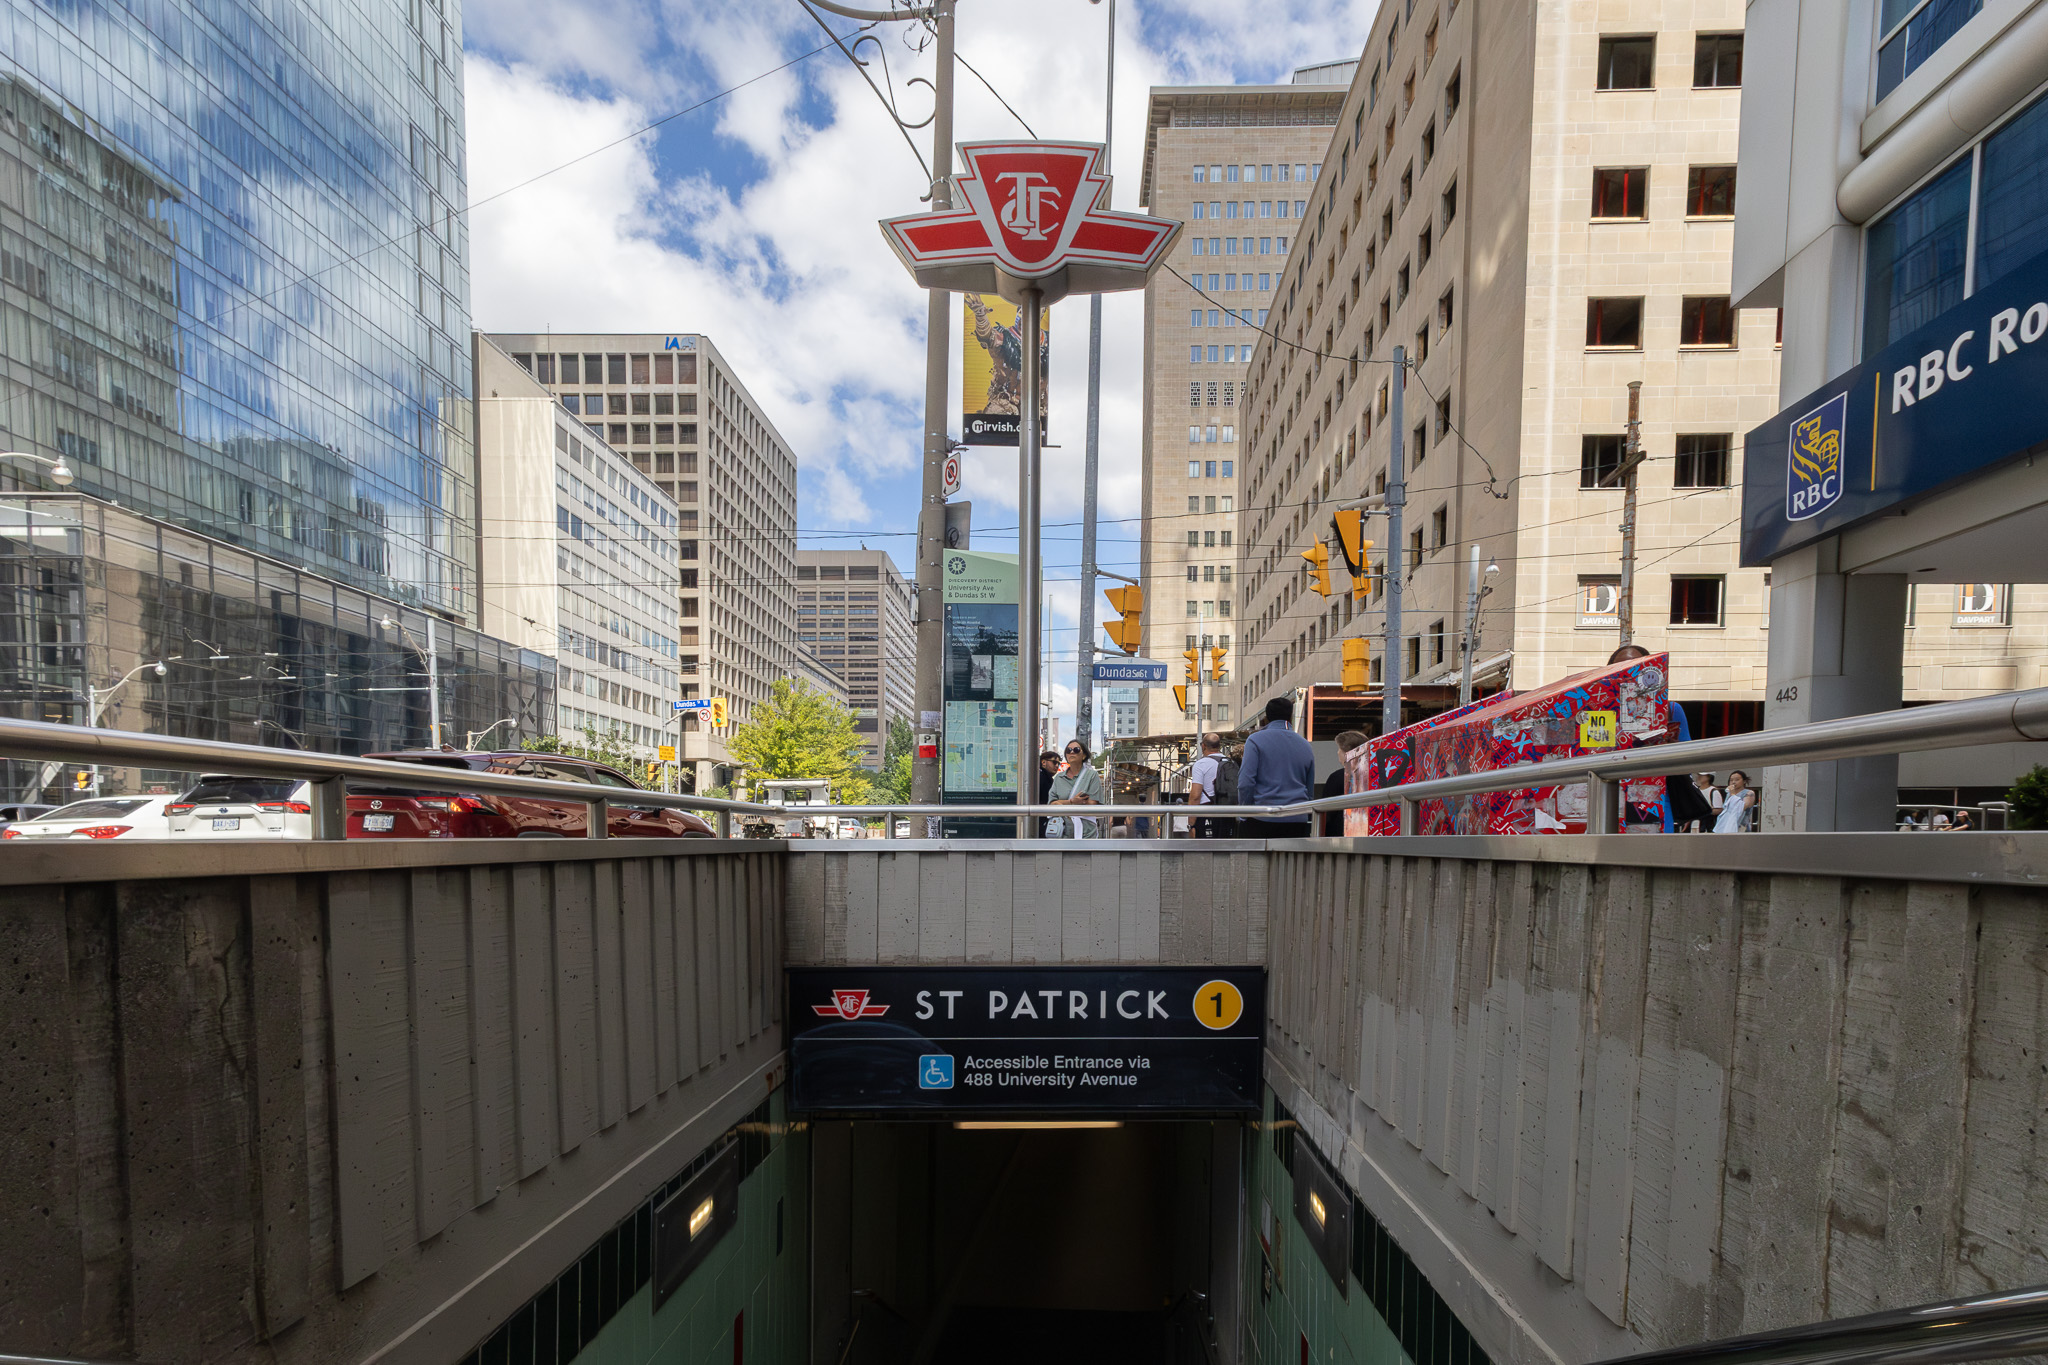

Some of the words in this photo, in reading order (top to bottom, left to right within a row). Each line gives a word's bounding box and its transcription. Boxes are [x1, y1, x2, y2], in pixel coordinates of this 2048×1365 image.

[1891, 330, 1976, 415] RBC
[1988, 301, 2048, 364] Ro
[1793, 475, 1836, 514] RBC
[1582, 617, 1619, 625] DAVPART
[1957, 616, 1996, 624] DAVPART
[1099, 666, 1137, 678] Dundas
[1776, 686, 1798, 702] 443
[676, 700, 697, 708] Dundas
[1590, 715, 1606, 728] NO
[1586, 729, 1610, 743] FUN
[915, 990, 964, 1020] ST
[988, 990, 1170, 1020] PATRICK
[1210, 992, 1223, 1018] 1
[964, 1055, 1049, 1070] Accessible
[1054, 1056, 1124, 1070] Entrance
[1127, 1056, 1151, 1070] via
[964, 1073, 994, 1086] 488
[997, 1073, 1075, 1089] University
[1080, 1073, 1138, 1086] Avenue
